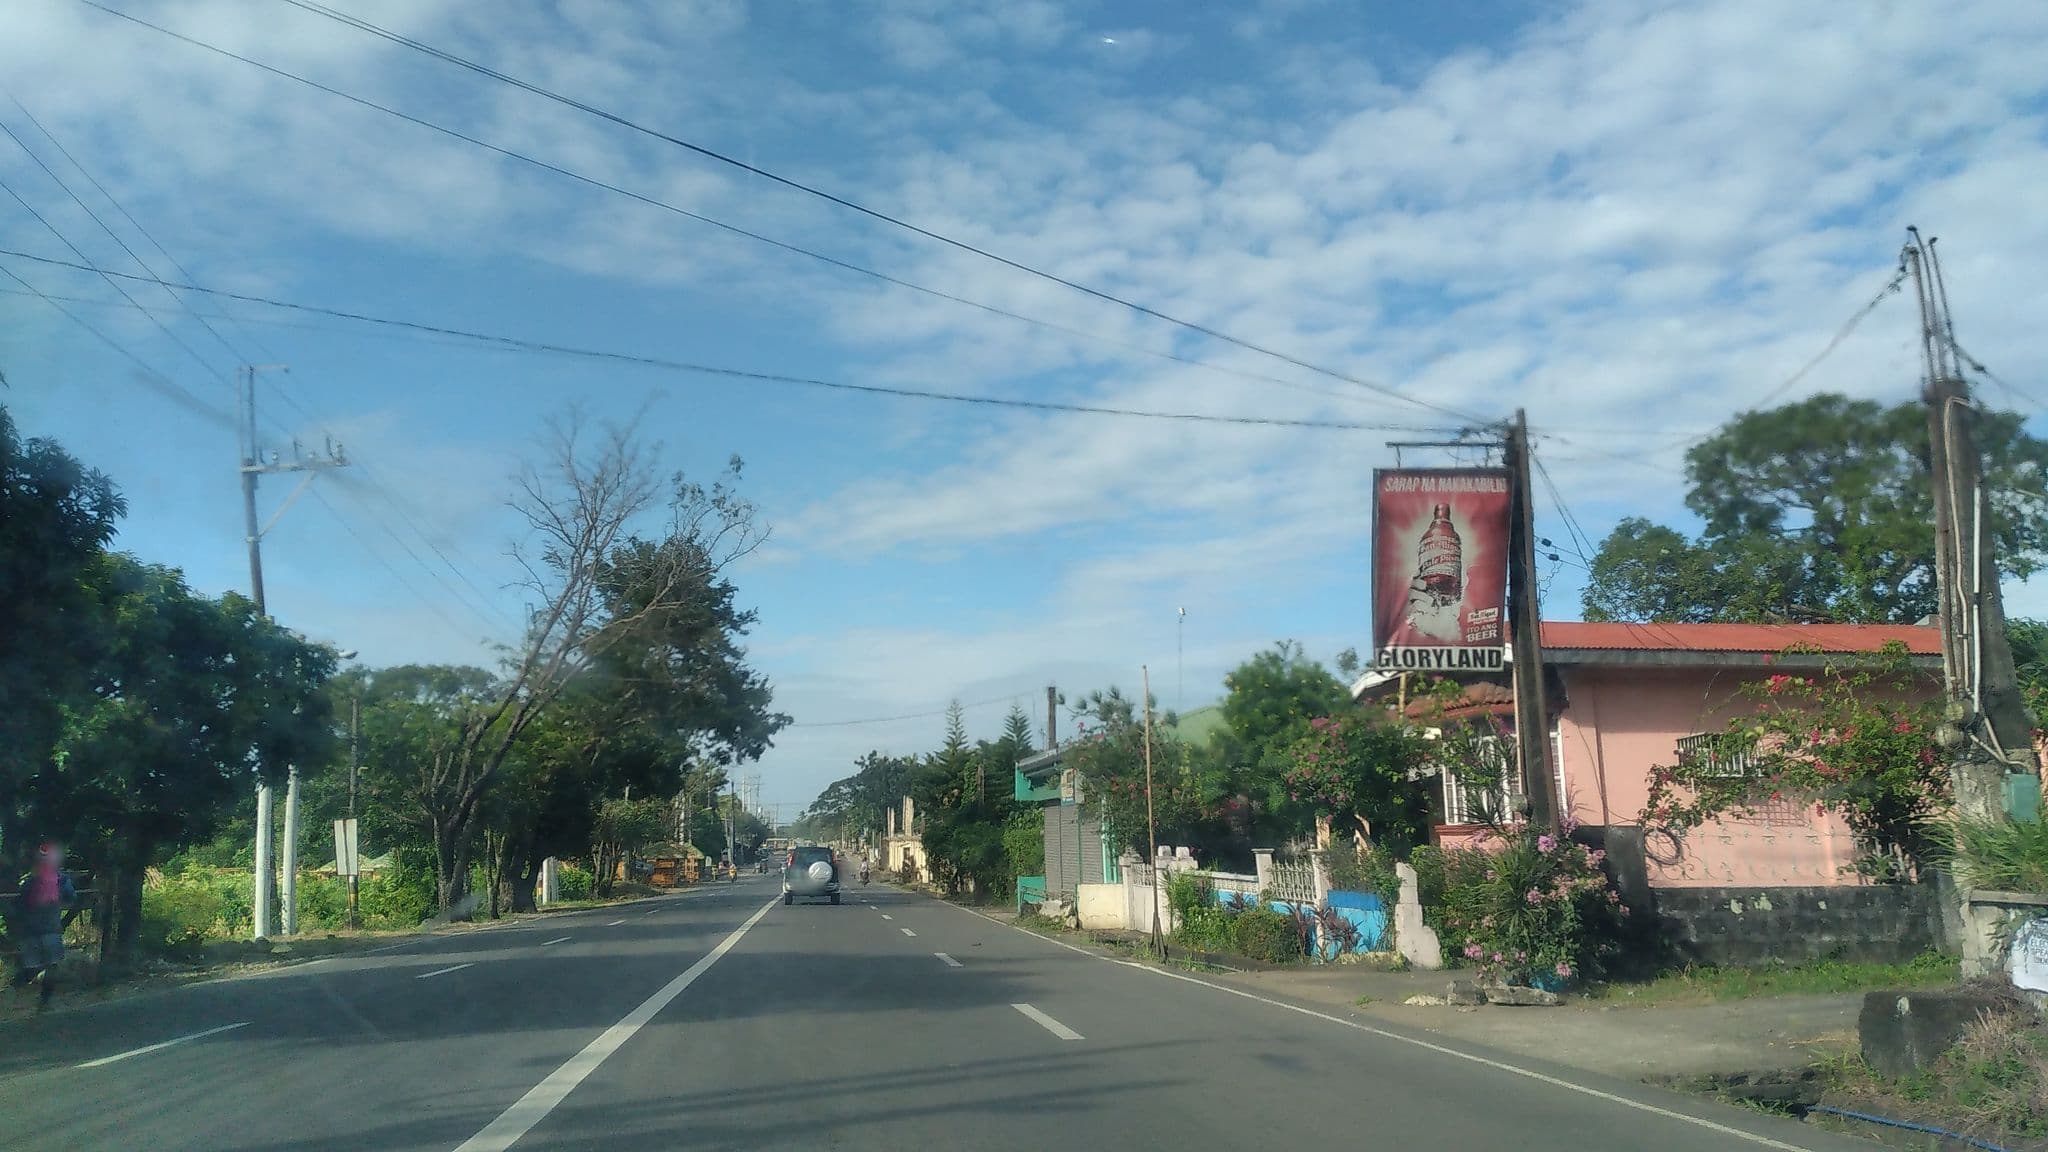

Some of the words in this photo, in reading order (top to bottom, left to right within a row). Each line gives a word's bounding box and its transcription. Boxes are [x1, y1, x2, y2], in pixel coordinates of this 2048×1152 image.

[1385, 477, 1419, 492] SARAP
[1421, 477, 1436, 492] NA
[1481, 623, 1497, 631] ANG
[1466, 629, 1497, 642] BEER
[1378, 648, 1502, 668] GLORYLAND
